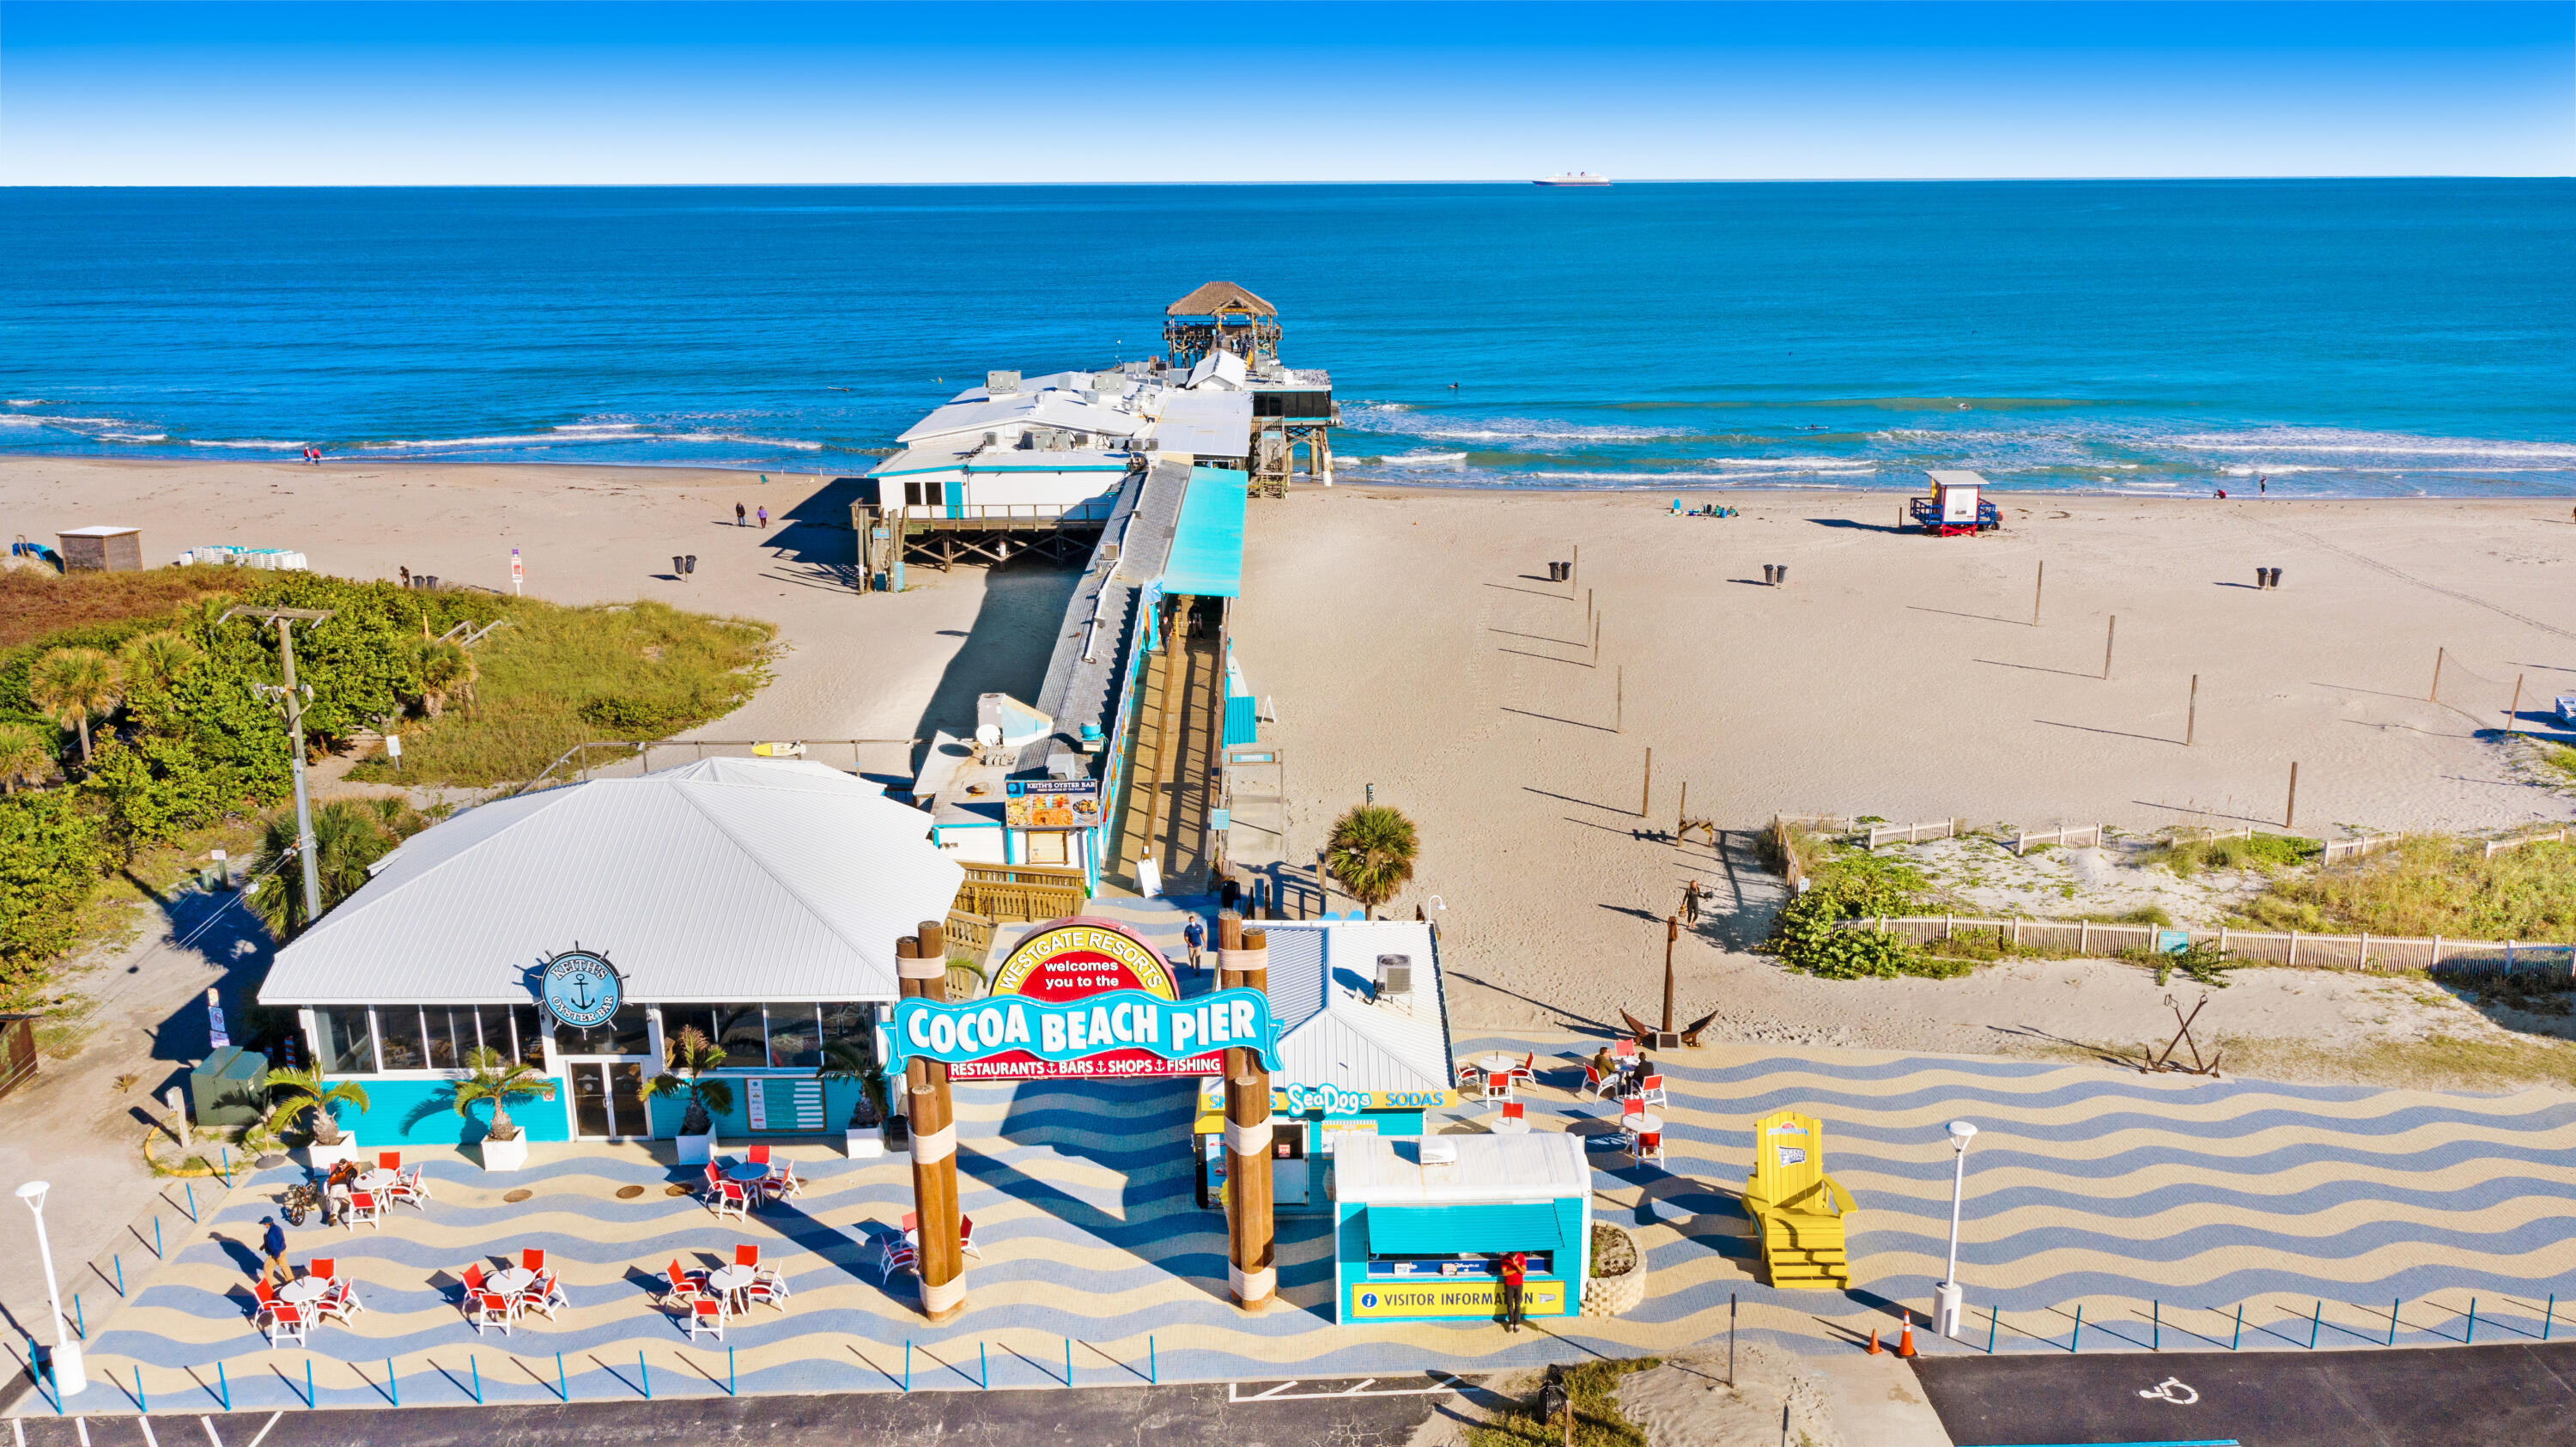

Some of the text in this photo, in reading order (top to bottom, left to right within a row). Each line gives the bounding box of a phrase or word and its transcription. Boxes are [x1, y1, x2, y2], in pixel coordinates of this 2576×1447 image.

[550, 959, 609, 980] KEITH'S
[999, 932, 1163, 991] WESTGATE RESORTS
[1044, 960, 1119, 972] welcomes
[1045, 976, 1120, 992] you to the
[552, 995, 614, 1022] OYSTER BAR
[908, 1000, 1257, 1054] COCOA BEACH PIER
[951, 1058, 1221, 1076] RESTAURANTS BARS SHOPS FISHING
[1386, 1091, 1444, 1107] SODAS
[1384, 1293, 1435, 1306] VISITOR
[1441, 1292, 1533, 1306] INFORMAN
